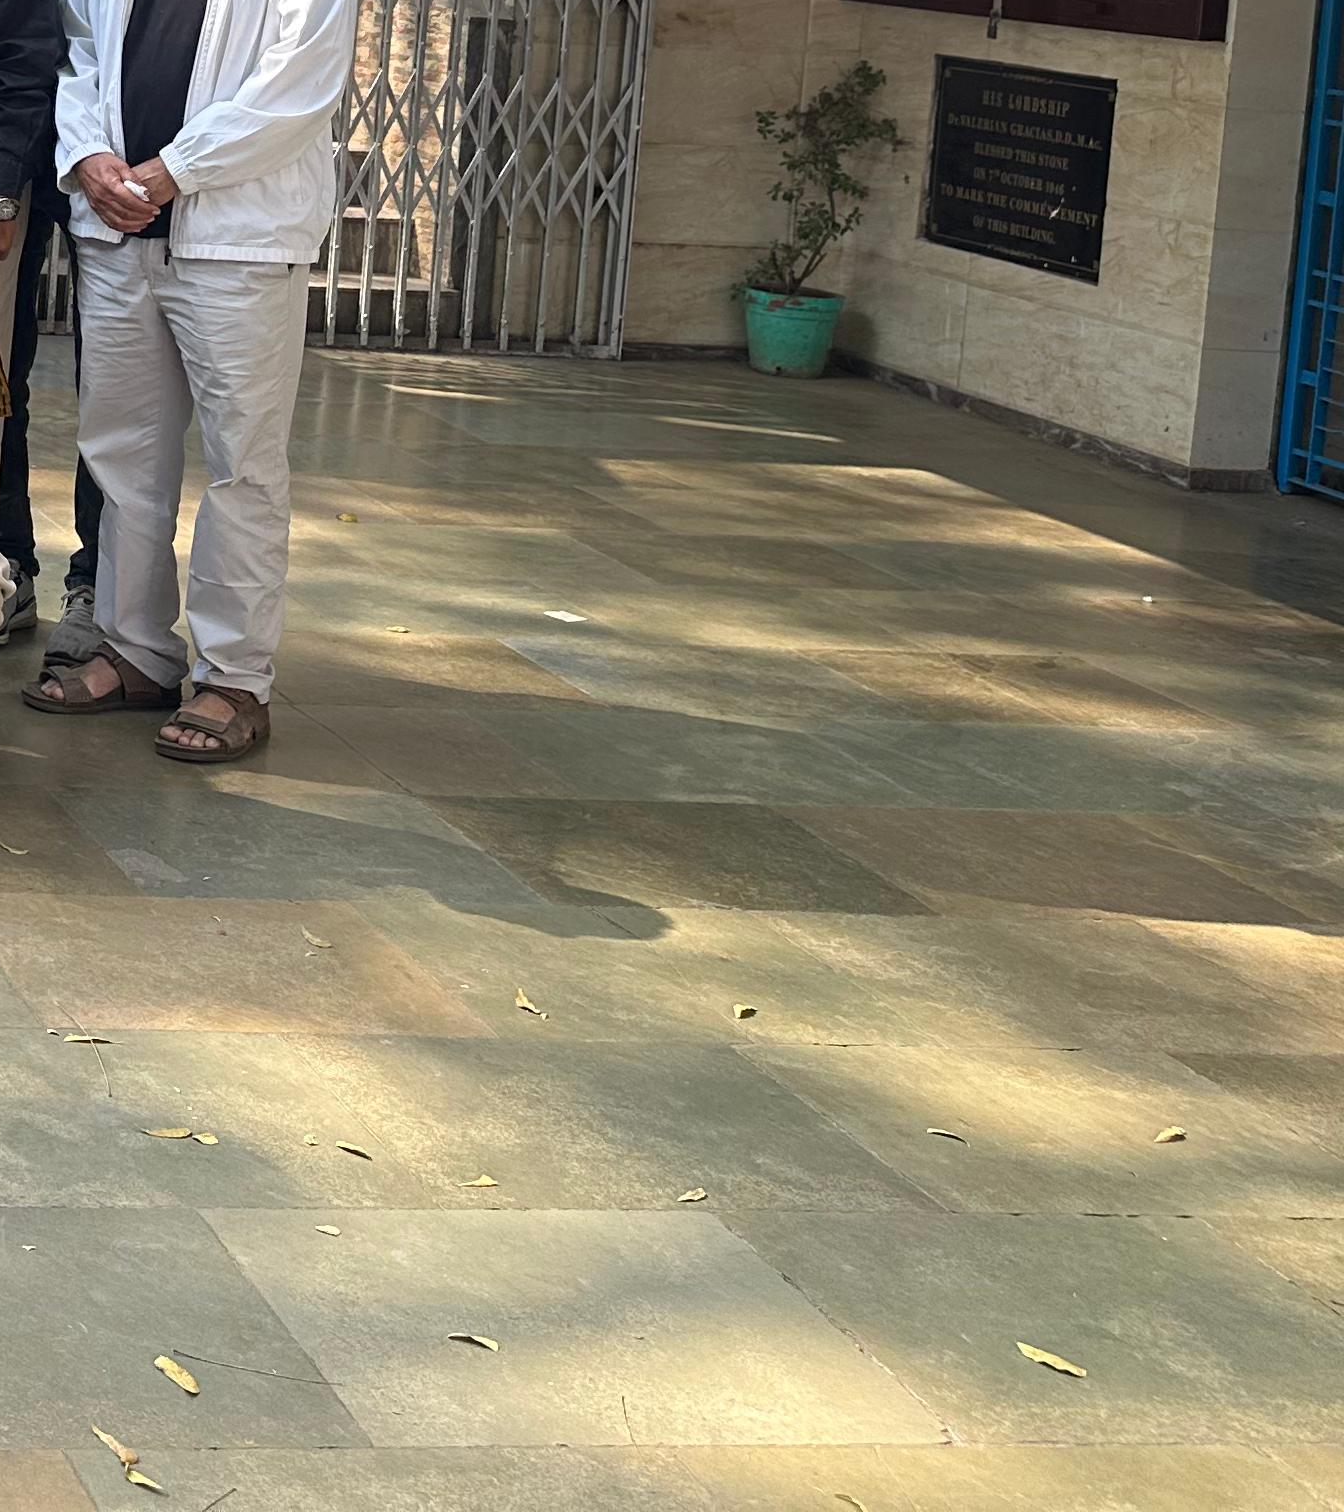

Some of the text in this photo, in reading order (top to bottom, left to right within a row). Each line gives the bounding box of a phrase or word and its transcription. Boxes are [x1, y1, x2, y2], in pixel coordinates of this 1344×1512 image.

[981, 90, 1072, 118] HIS LORDSHIP
[973, 141, 1070, 171] BLESSED THIS STONE
[973, 167, 986, 180] ON
[1000, 172, 1043, 191] OCTOBER
[940, 183, 1099, 228] TO MARK THE COMMEEMENT
[972, 214, 984, 228] OF
[986, 218, 1009, 235] THIS
